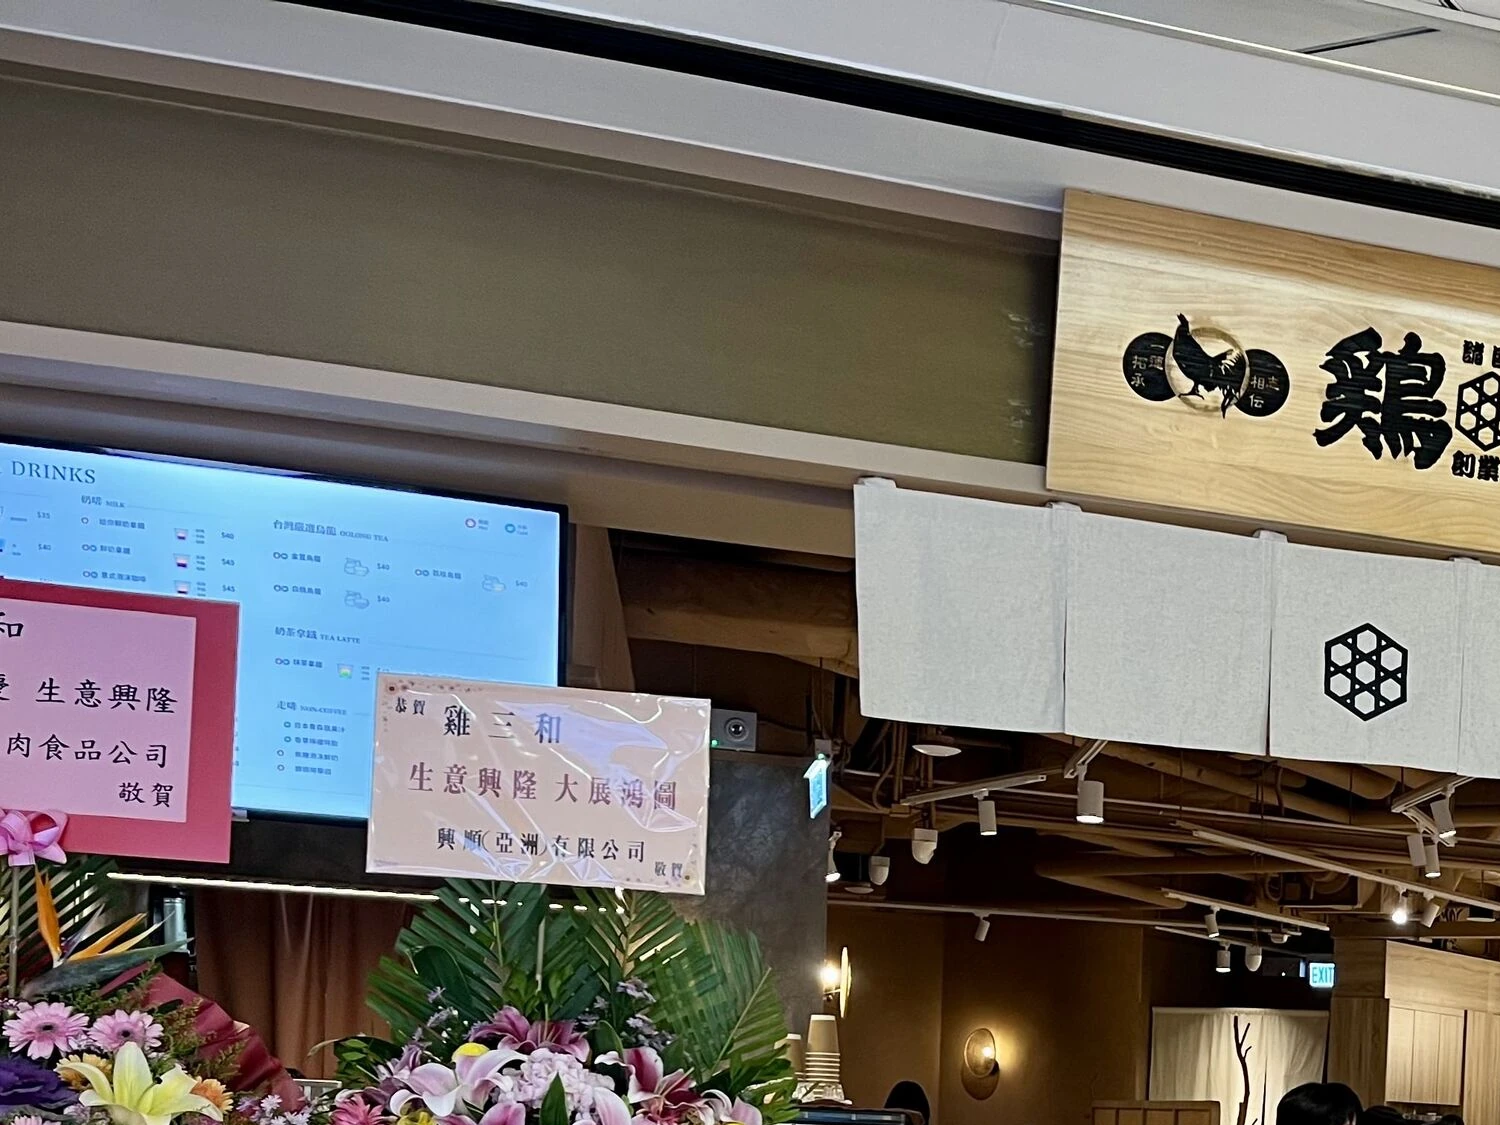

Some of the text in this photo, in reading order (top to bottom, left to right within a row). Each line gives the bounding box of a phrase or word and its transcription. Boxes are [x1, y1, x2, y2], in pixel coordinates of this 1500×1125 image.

[11, 460, 96, 485] DRINKS
[373, 535, 389, 543] TEA
[320, 634, 335, 642] TEA
[337, 636, 360, 644] LATTE
[35, 677, 178, 714] 生意興隆
[395, 696, 562, 744] 恭賀 雞三和
[7, 732, 168, 769] 肉食品公司
[119, 782, 174, 808] 敬賀
[408, 761, 678, 811] 生意興隆 大展鴻圖
[654, 860, 683, 879] 敬賀
[1312, 966, 1335, 984] EXIT
